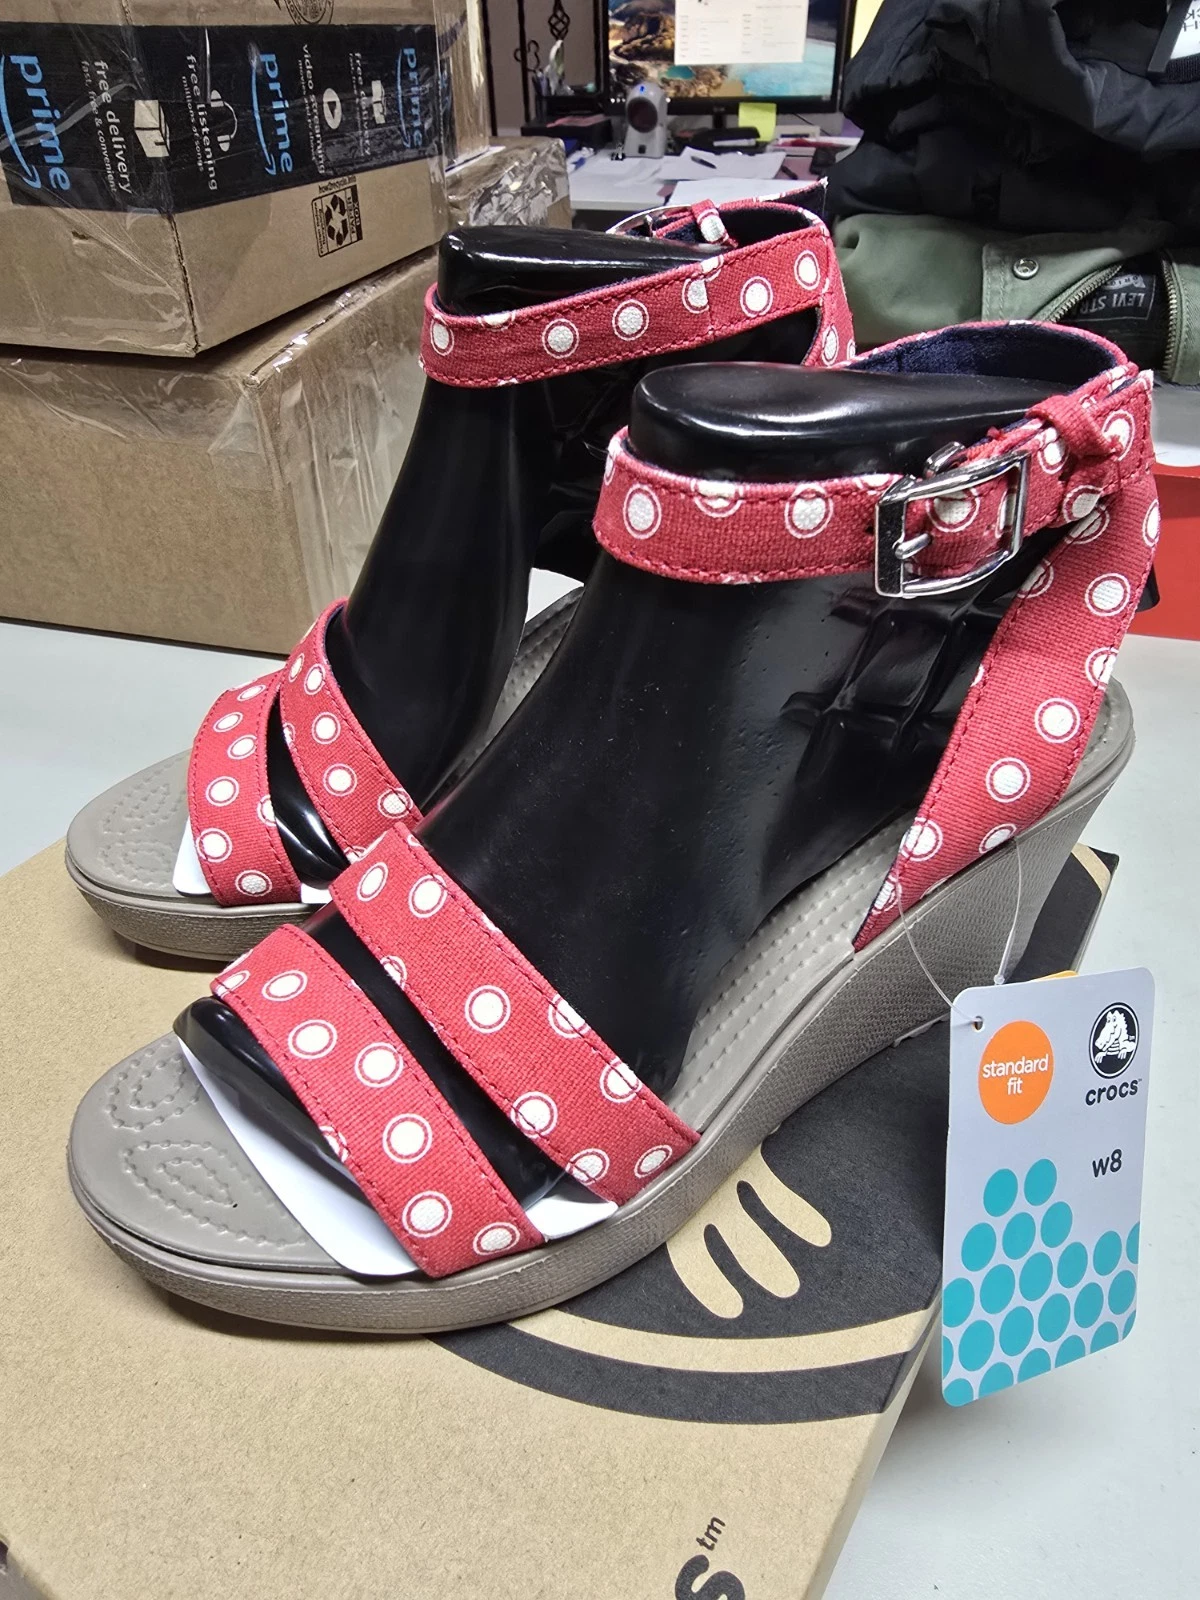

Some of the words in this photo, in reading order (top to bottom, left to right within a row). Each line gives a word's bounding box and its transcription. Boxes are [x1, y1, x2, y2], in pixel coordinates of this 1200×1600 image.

[355, 52, 363, 86] free
[10, 55, 71, 191] prime
[182, 76, 196, 123] millions
[186, 55, 200, 97] free
[197, 103, 217, 190] listening
[259, 54, 293, 173] prime
[303, 44, 314, 90] video
[309, 94, 326, 174] streaming
[403, 48, 422, 147] prime
[94, 60, 112, 104] free
[106, 110, 133, 194] delivery
[97, 130, 117, 193] convenient
[1110, 292, 1146, 308] LEVI
[982, 1054, 1049, 1079] standard
[1007, 1076, 1024, 1095] fit
[1085, 1079, 1139, 1106] crocs
[1092, 1148, 1122, 1178] w8
